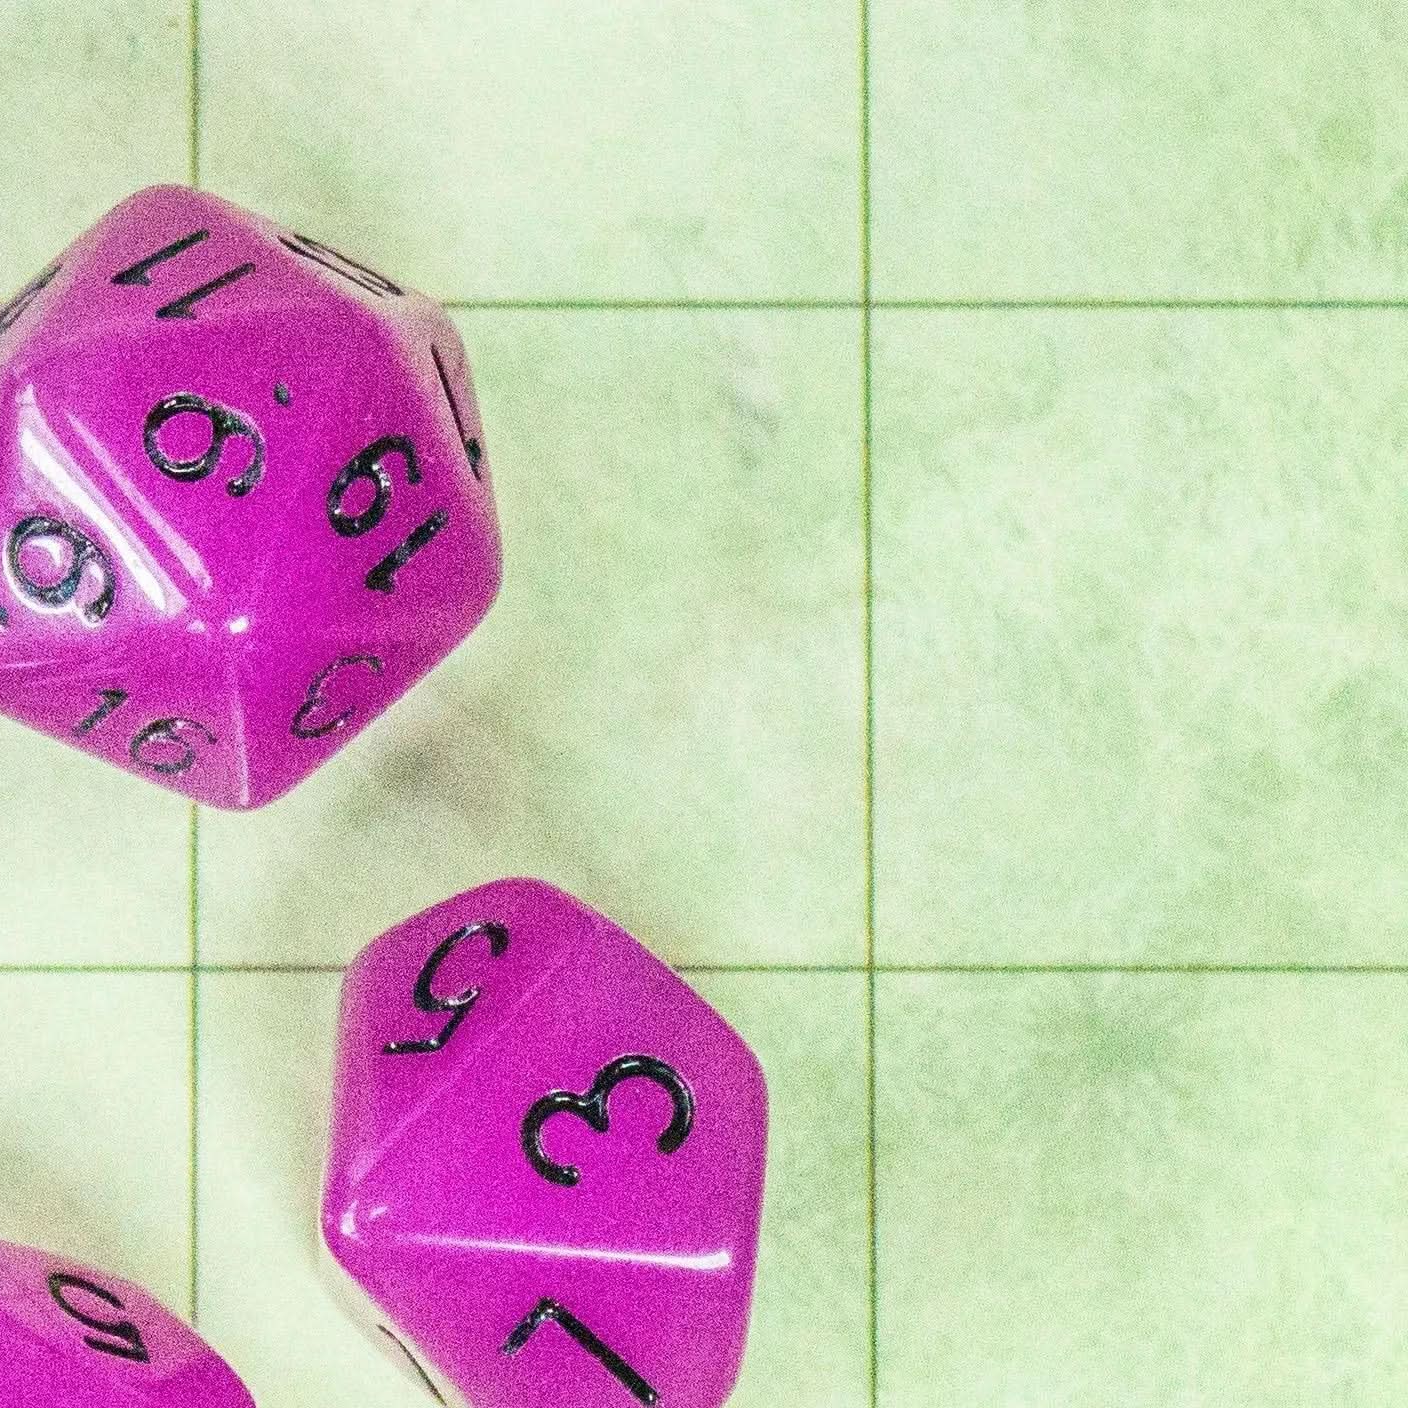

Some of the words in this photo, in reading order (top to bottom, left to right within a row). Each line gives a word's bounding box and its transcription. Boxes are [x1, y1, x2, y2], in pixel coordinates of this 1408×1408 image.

[325, 432, 451, 596] 19
[79, 687, 218, 775] 16
[289, 653, 383, 741] 3
[380, 920, 512, 1057] 5
[519, 1053, 697, 1189] 3
